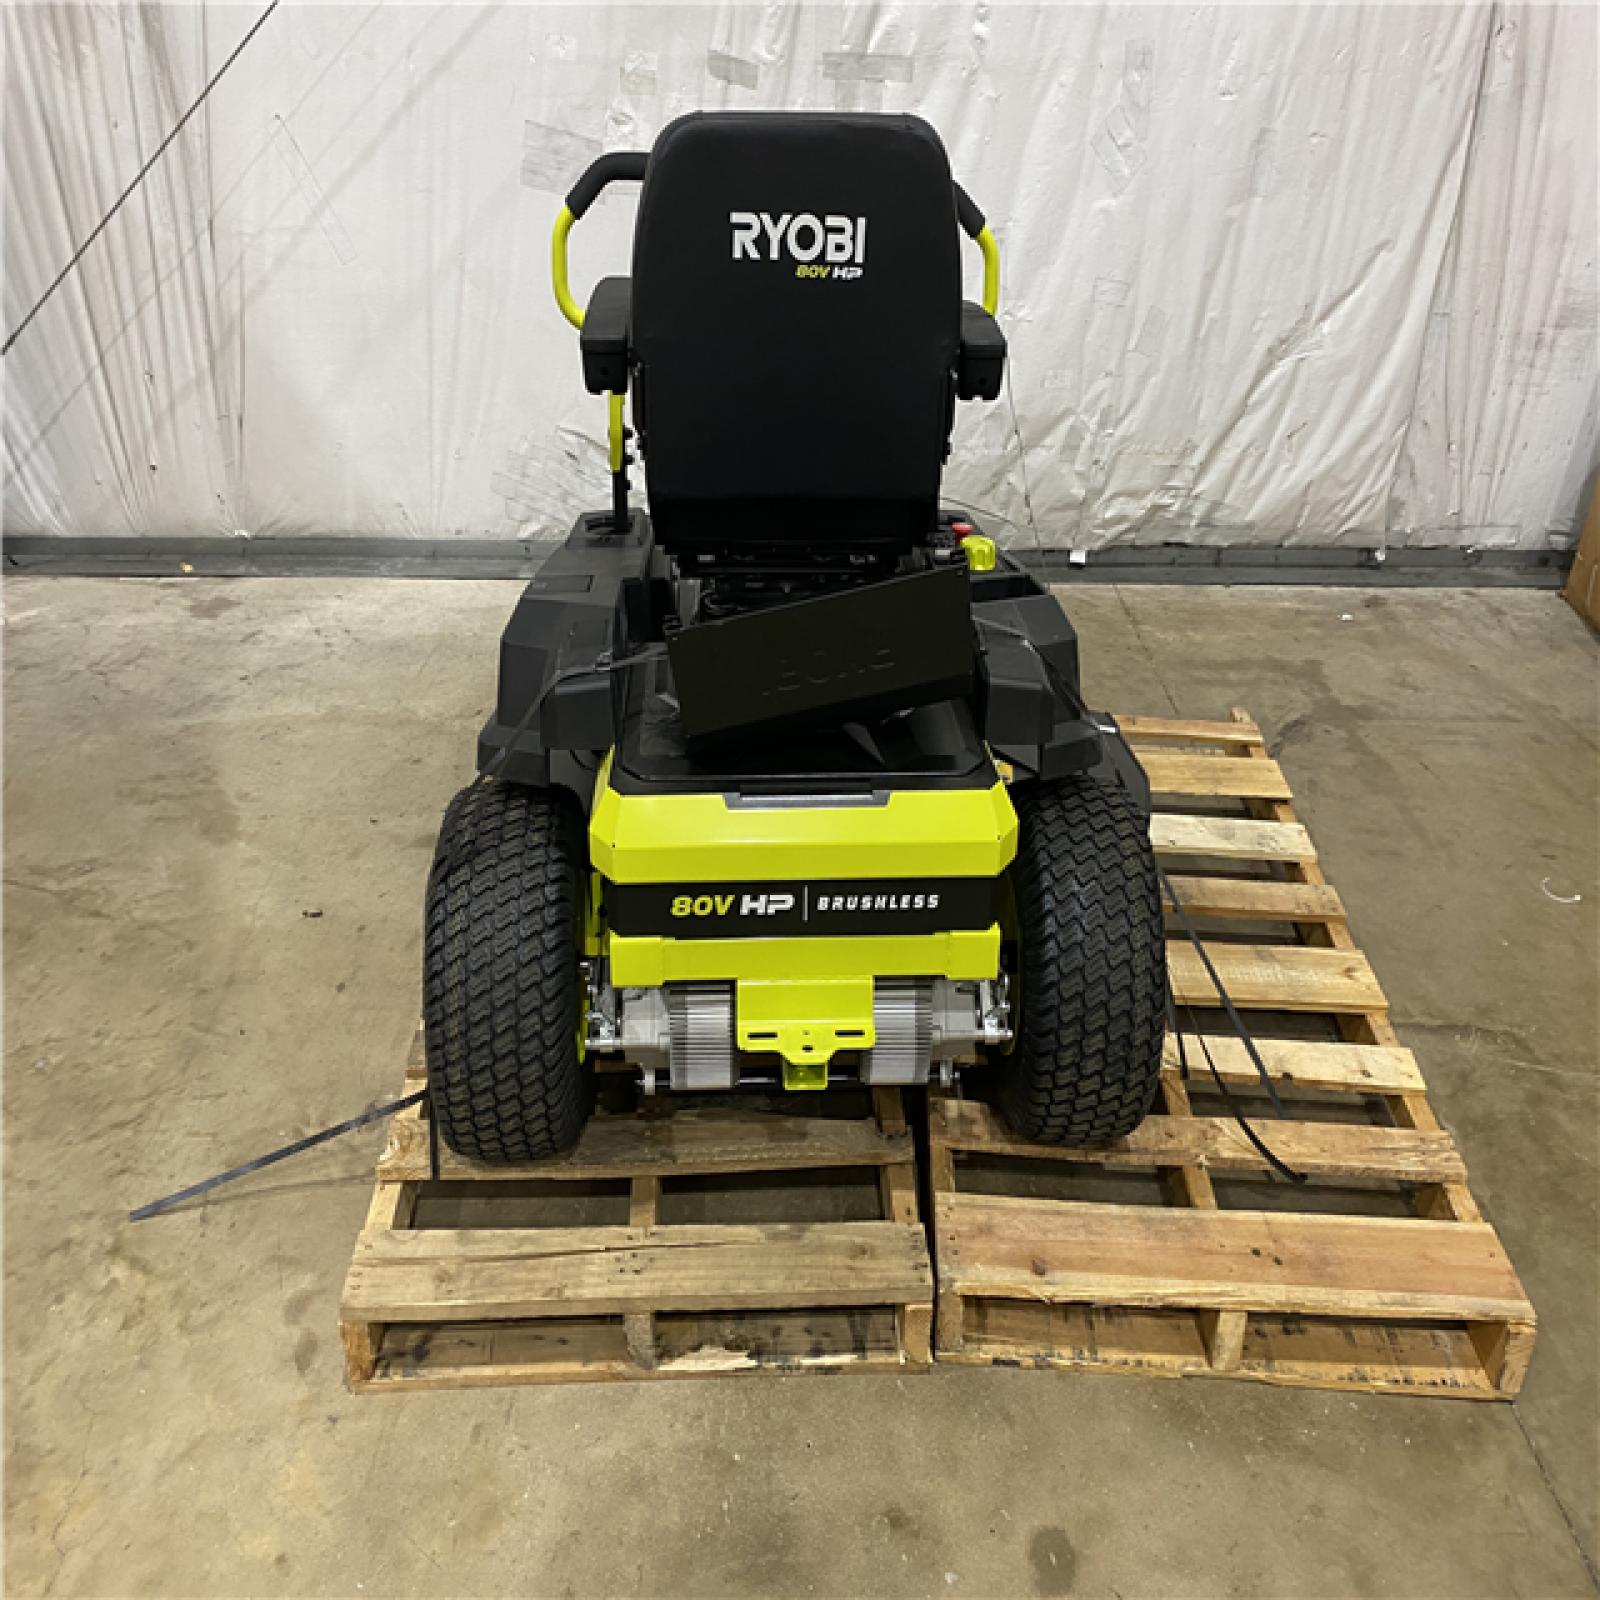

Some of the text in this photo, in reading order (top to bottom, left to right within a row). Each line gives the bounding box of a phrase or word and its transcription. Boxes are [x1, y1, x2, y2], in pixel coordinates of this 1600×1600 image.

[730, 211, 866, 263] RYOBI
[796, 265, 863, 279] 80V HP
[671, 894, 940, 916] 80V HP BRUSHLESS
